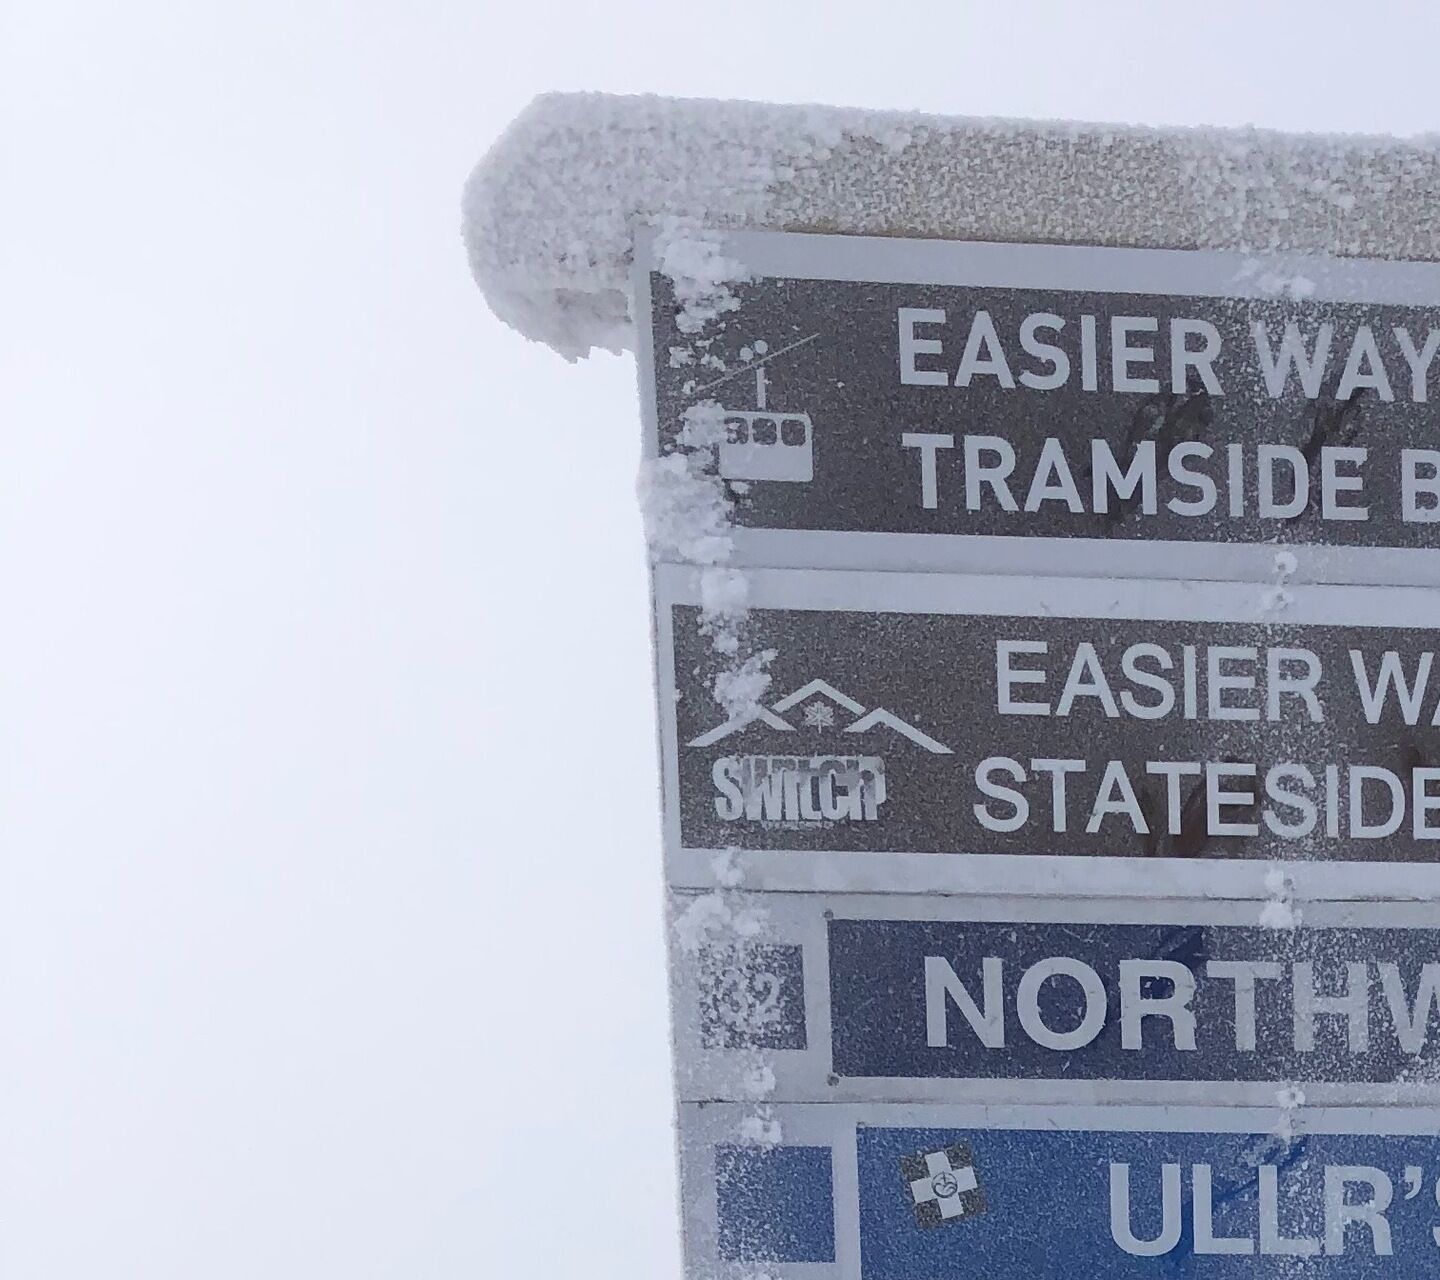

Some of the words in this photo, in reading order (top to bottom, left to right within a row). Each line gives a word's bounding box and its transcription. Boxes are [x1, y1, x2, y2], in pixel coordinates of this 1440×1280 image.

[898, 306, 1225, 397] EASIER
[902, 432, 1370, 522] TRAMSIDE
[996, 639, 1325, 723] EASIER
